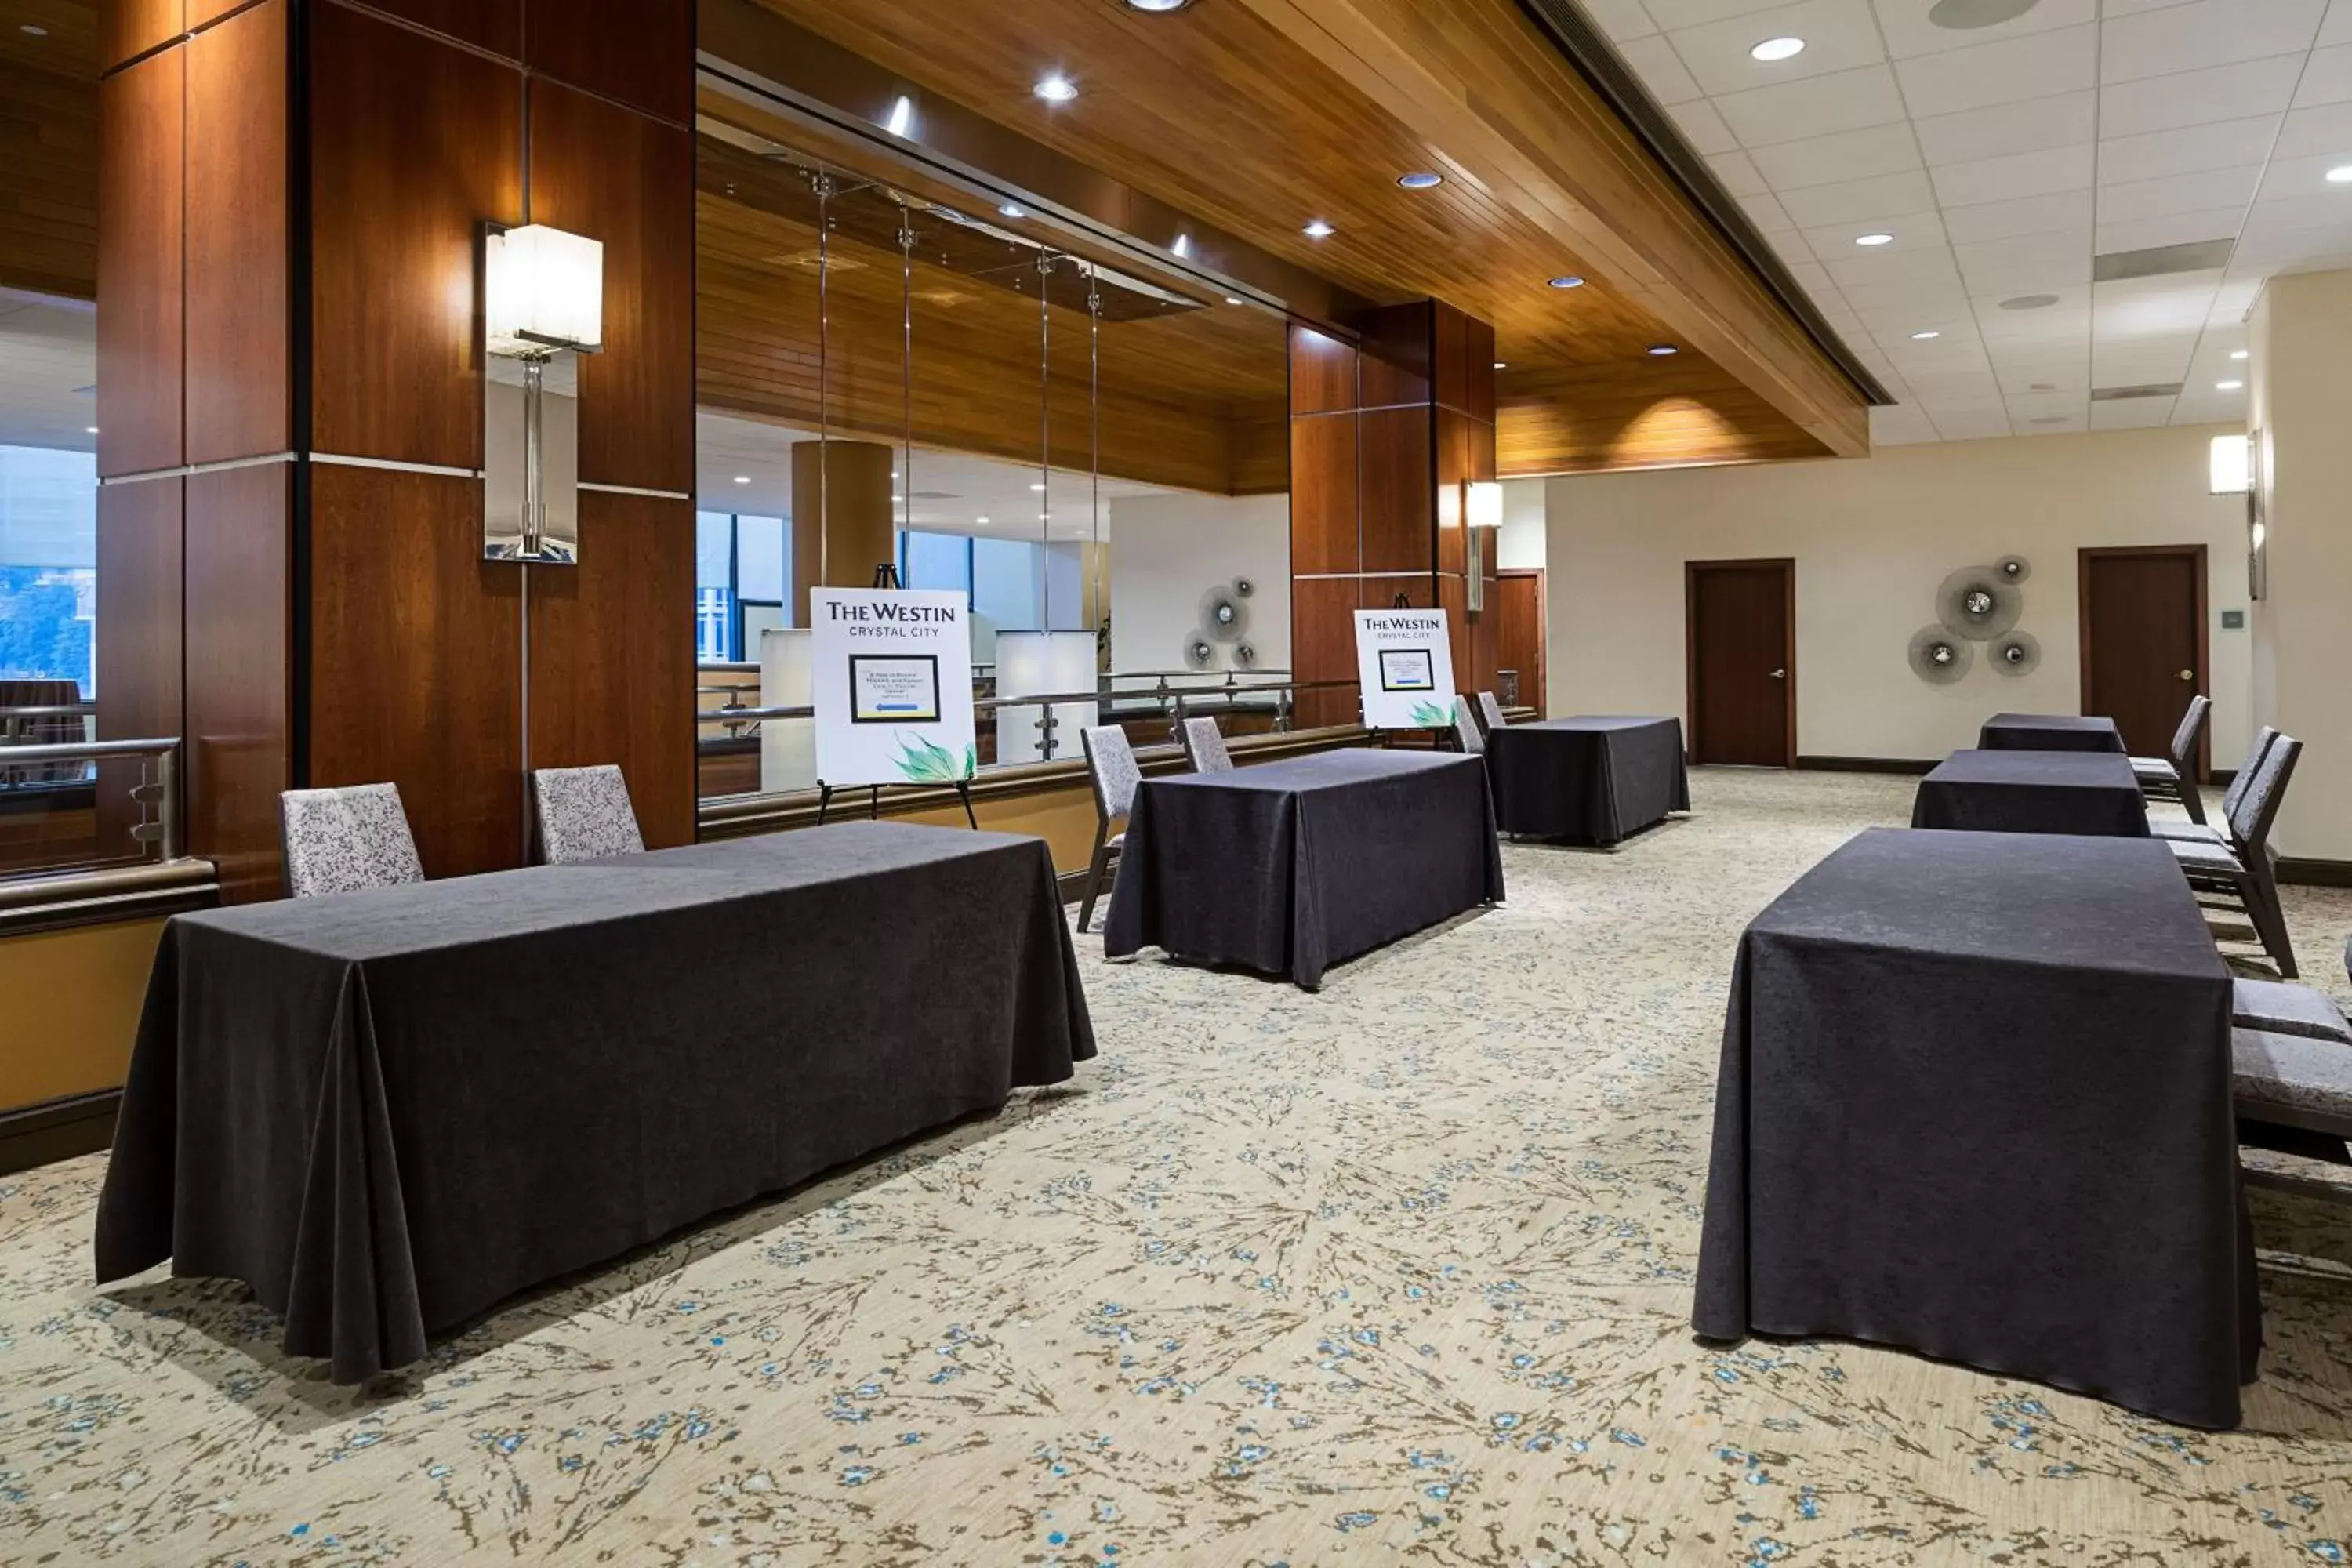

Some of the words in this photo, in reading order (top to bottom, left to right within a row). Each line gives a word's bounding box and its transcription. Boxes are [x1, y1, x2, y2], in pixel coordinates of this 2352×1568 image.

[826, 601, 870, 621] THE
[871, 603, 955, 622] WESTIN
[1363, 617, 1389, 630] THE
[1389, 617, 1439, 630] WESTIN
[849, 626, 906, 637] CRYSTAL
[910, 627, 939, 637] CITY
